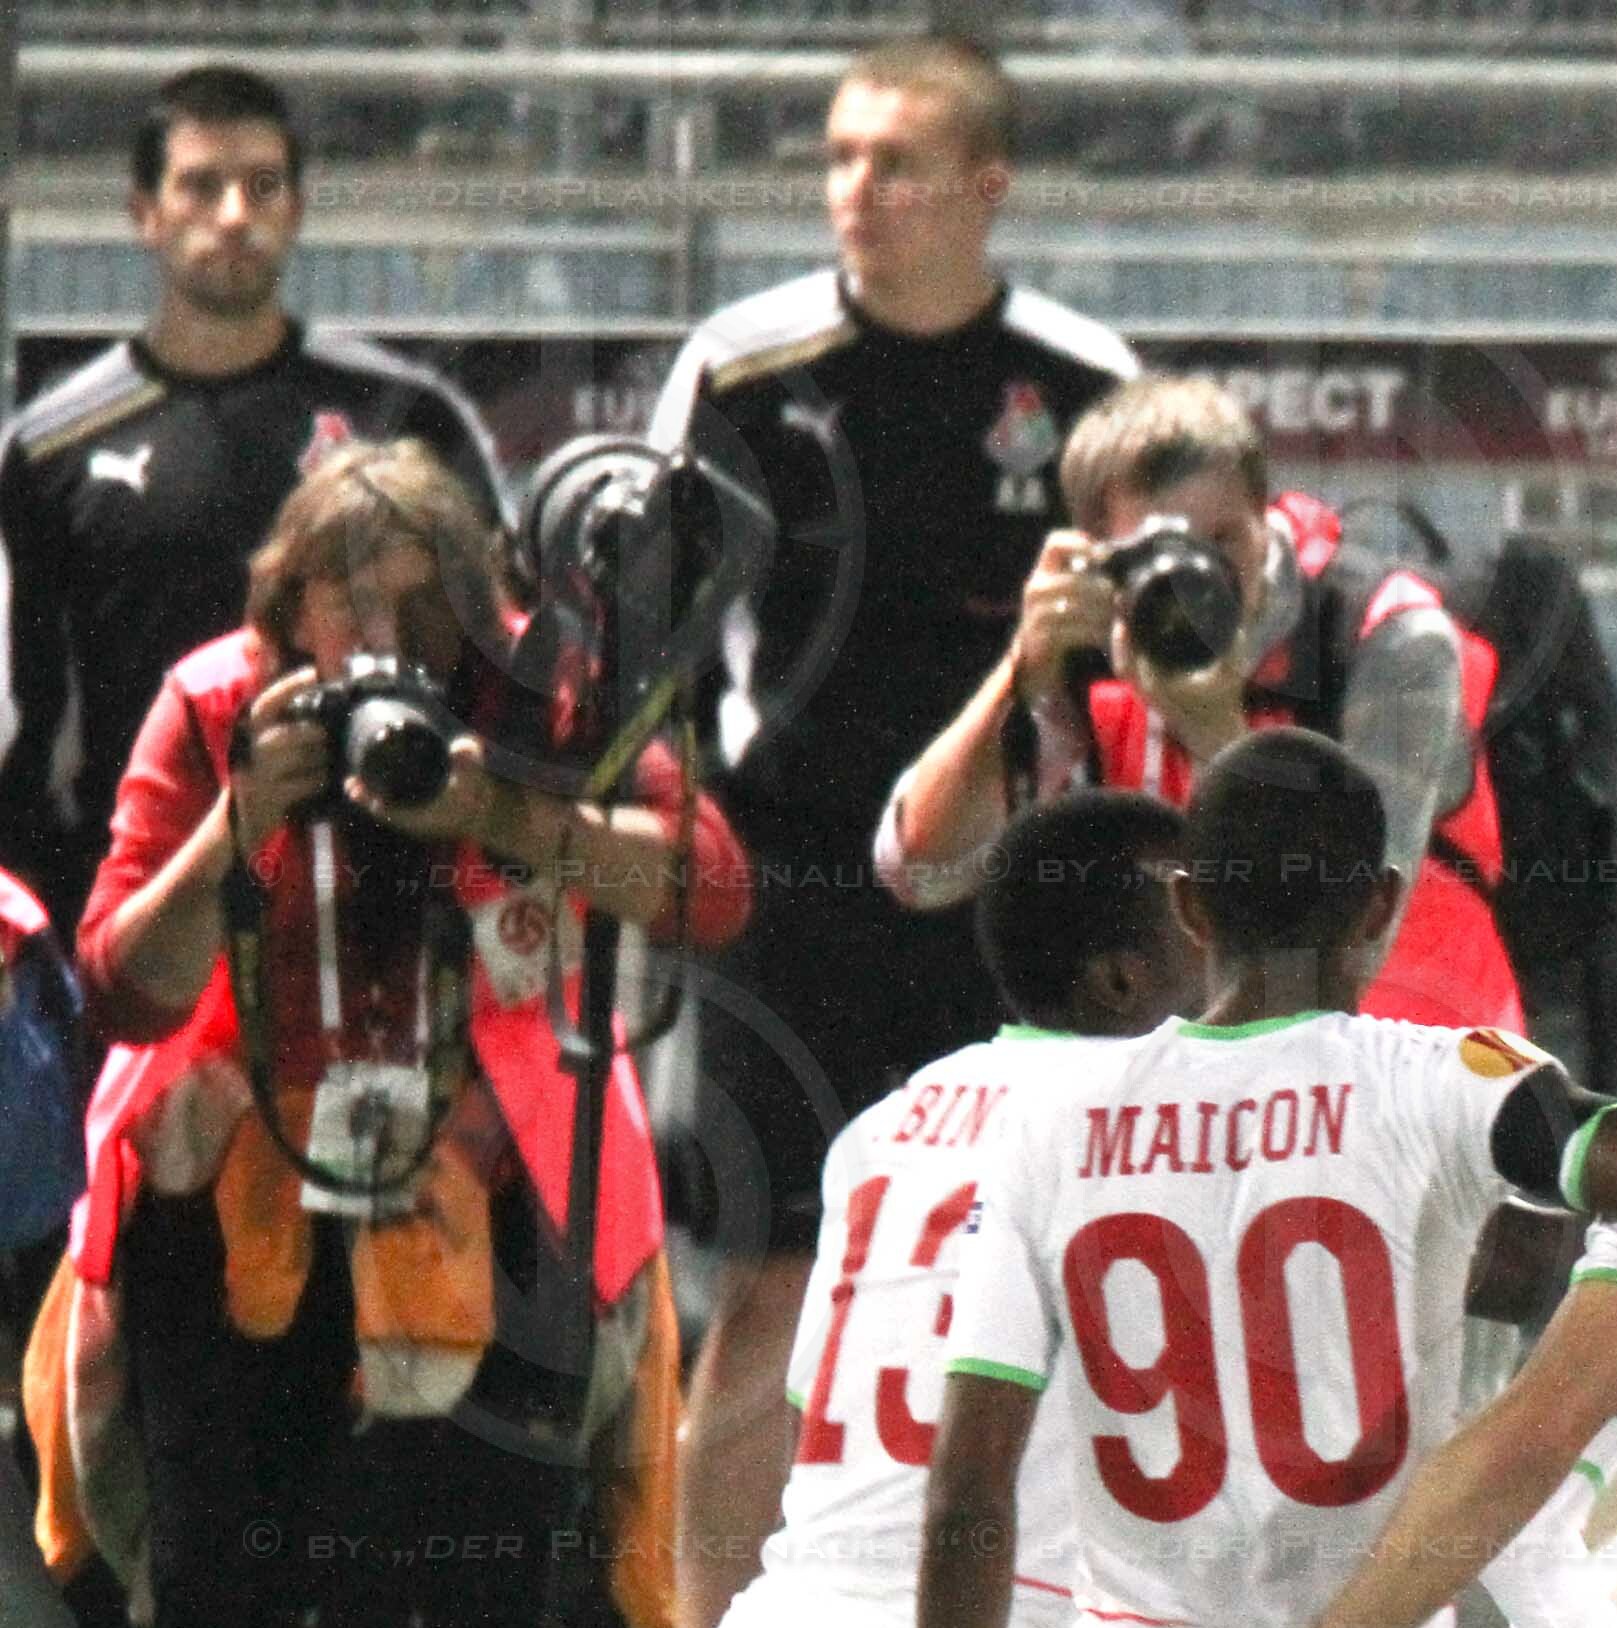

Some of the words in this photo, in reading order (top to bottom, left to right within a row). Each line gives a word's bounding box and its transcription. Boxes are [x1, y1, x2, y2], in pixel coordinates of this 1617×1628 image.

[890, 1083, 1009, 1152] BIN
[1078, 1083, 1353, 1179] MAICON
[1062, 1195, 1410, 1523] 90
